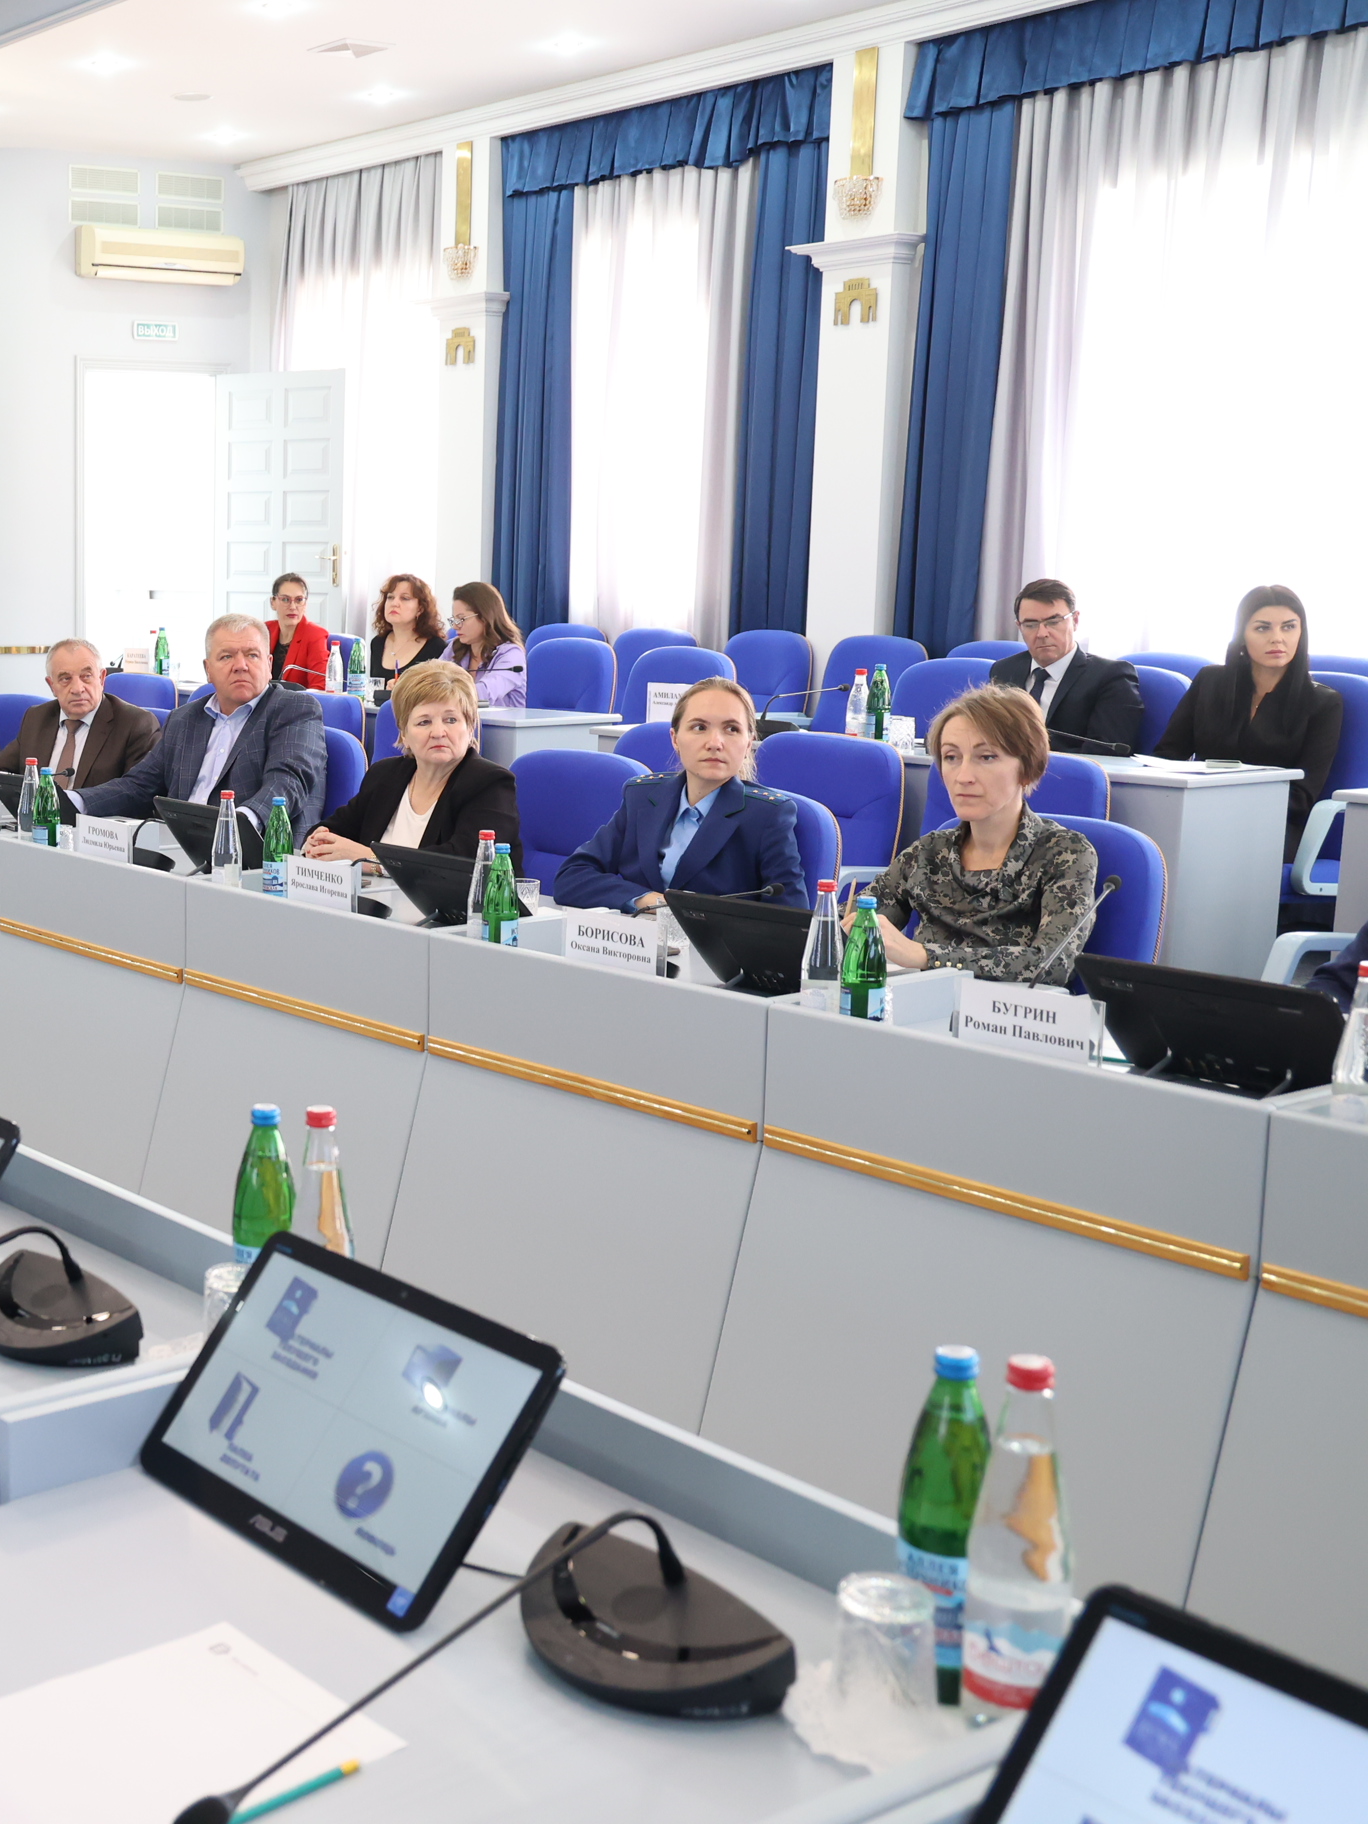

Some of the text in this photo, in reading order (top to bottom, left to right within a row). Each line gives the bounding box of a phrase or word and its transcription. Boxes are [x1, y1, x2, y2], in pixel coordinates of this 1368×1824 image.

[138, 325, 175, 337] ВЫХОД
[88, 826, 119, 841] ГРОМОВА
[82, 836, 126, 853] Людмила Юрьевна
[296, 866, 343, 885] ТИМЧЕНКО
[291, 879, 348, 898] Ярослава Игоревна
[578, 925, 645, 948] БОРИСОВА
[570, 940, 651, 963] Оксана Викторовна
[992, 1000, 1057, 1024] БУГРИН
[965, 1015, 1084, 1050] Роман Павлович
[249, 1513, 288, 1543] ASUS
